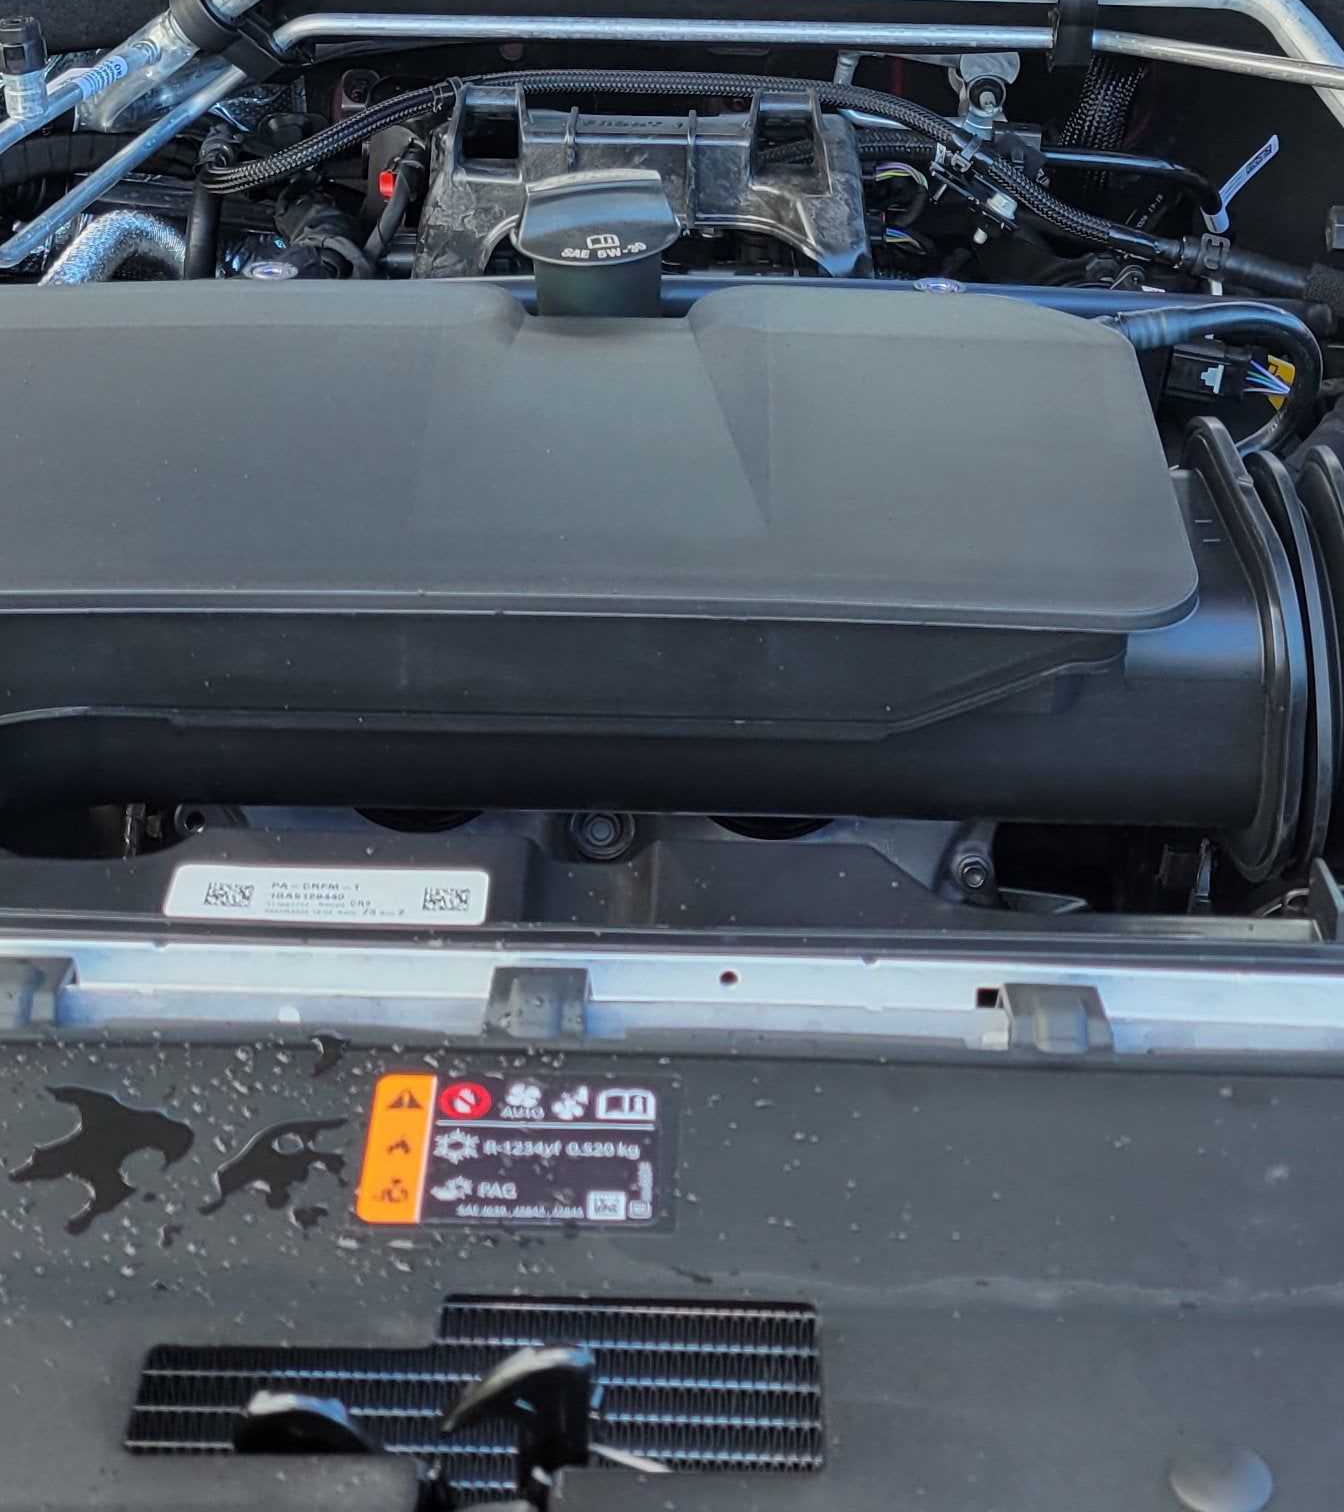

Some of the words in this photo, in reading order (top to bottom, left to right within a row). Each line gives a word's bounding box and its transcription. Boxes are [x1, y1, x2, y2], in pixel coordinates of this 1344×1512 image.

[561, 247, 591, 259] SAE
[499, 1105, 545, 1120] AUTO
[617, 1141, 641, 1160] kg
[477, 1182, 517, 1199] PAG
